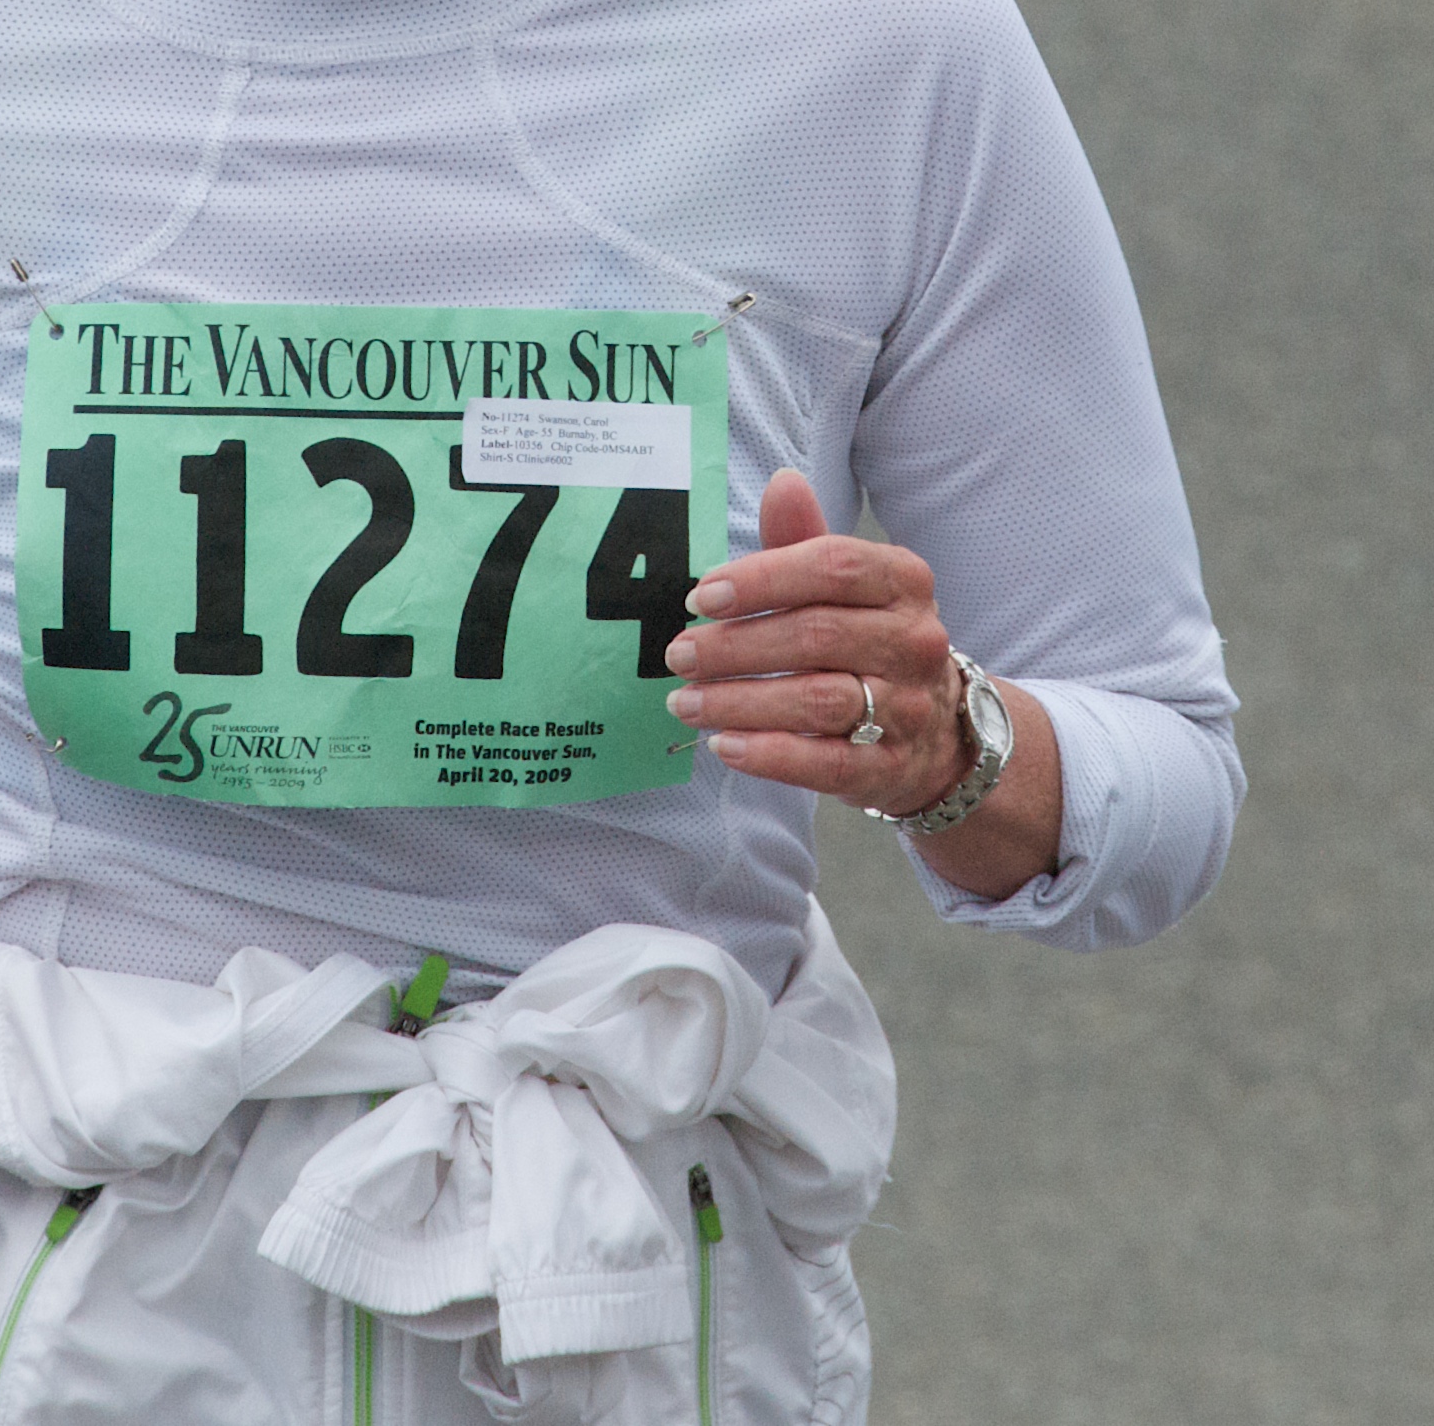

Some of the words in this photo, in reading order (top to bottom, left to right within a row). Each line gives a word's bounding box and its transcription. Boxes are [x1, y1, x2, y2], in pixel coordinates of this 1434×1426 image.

[77, 323, 192, 397] THE
[205, 324, 552, 401] VANCOUVER
[568, 329, 681, 406] SUN
[583, 416, 609, 427] Carol
[602, 430, 618, 441] BC
[550, 441, 573, 454] Chip
[41, 433, 700, 679] 11274
[211, 724, 227, 733] THE
[229, 724, 280, 734] VANCOUVER
[415, 719, 495, 739] Complete
[500, 721, 540, 736] Race
[545, 720, 605, 736] Results
[414, 743, 430, 759] in
[436, 744, 466, 760] The
[471, 744, 558, 761] Vancouver
[562, 744, 596, 760] Sun,
[210, 762, 251, 781] years
[254, 760, 328, 786] running
[437, 766, 484, 786] April
[489, 767, 518, 787] 20,
[524, 767, 573, 785] 2009
[220, 775, 254, 790] 1985
[268, 778, 307, 791] 2009
